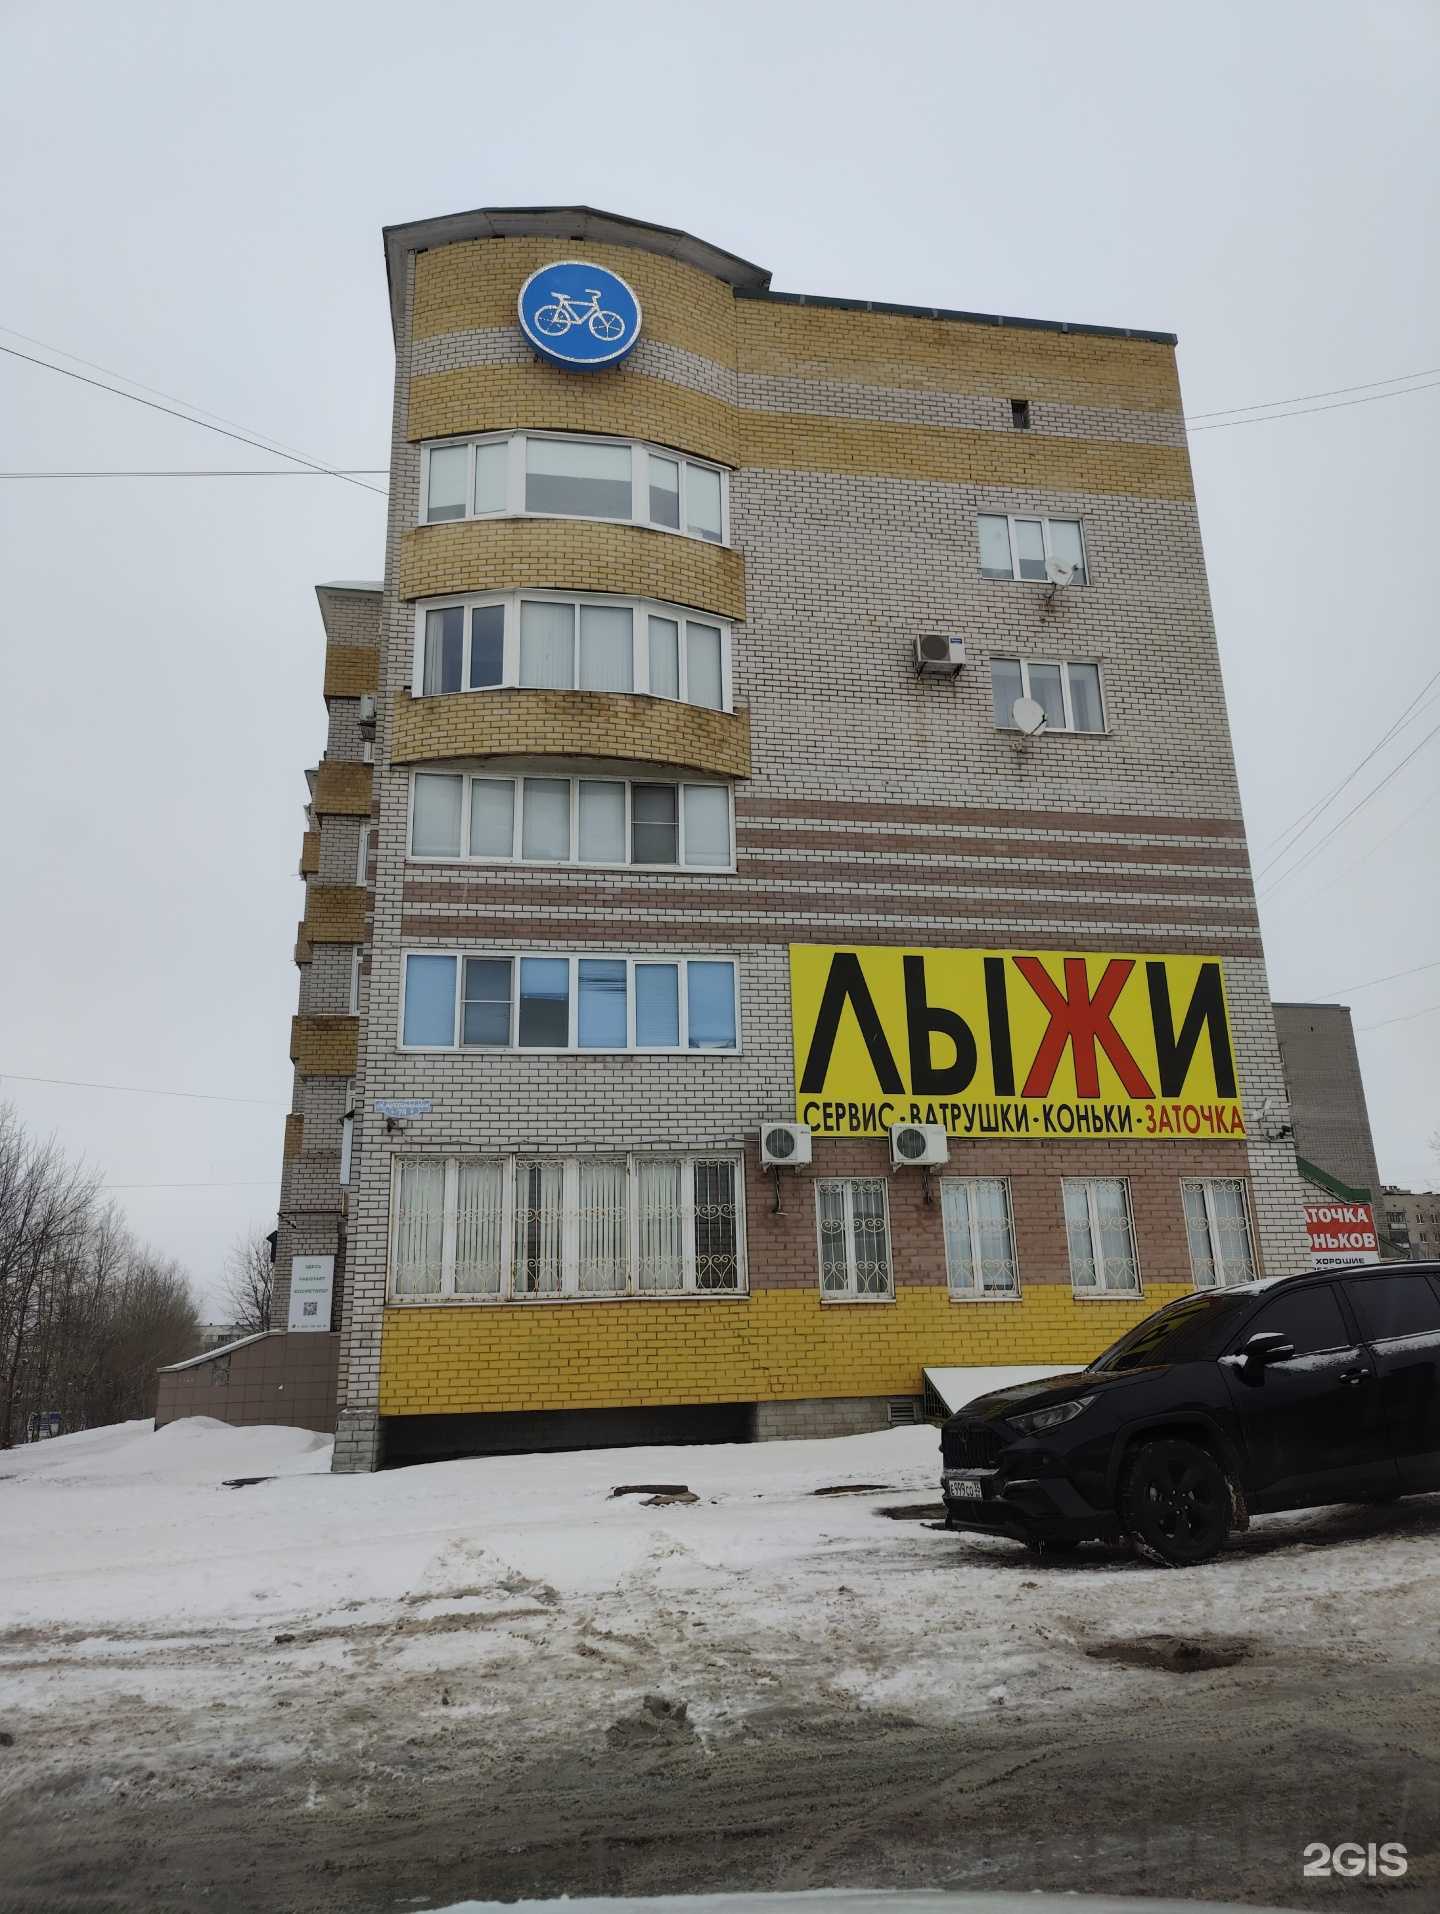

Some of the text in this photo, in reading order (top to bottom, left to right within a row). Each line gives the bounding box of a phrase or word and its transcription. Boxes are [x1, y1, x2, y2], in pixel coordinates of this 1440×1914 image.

[799, 952, 1238, 1098] ЛЫЖИ
[803, 1101, 1246, 1134] СЕРВИС ВАТРУШКИ КОНЬКИ ЗАТОЧКА
[1310, 1233, 1376, 1248] НЬКОВ
